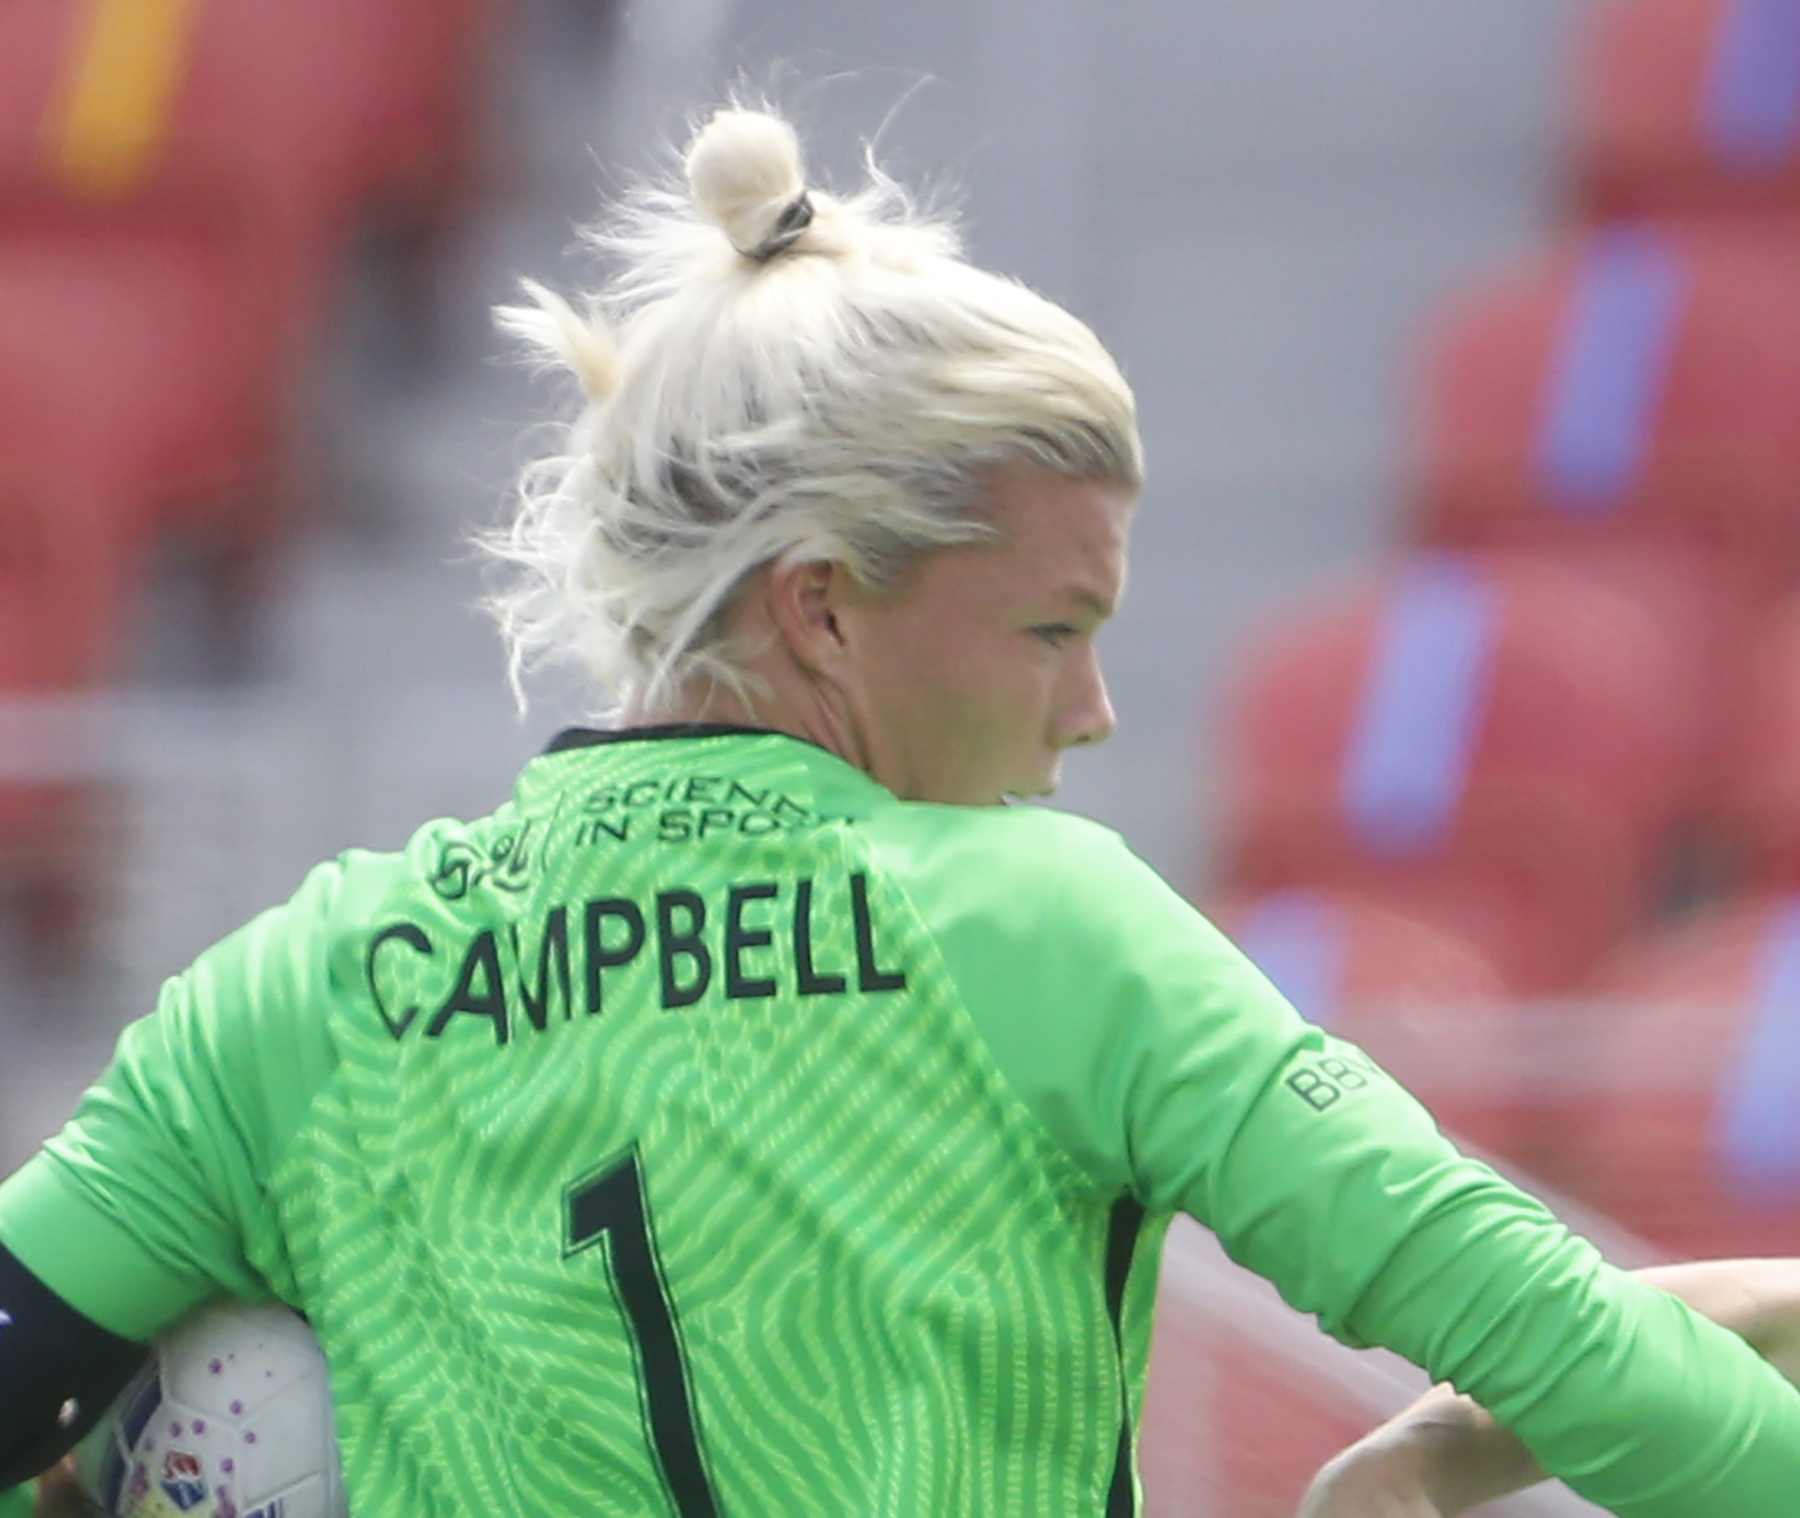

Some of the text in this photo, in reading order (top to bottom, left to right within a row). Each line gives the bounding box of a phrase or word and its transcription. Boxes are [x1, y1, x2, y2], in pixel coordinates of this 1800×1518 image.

[582, 776, 811, 818] SCIEN
[574, 808, 845, 848] IN SPO
[366, 872, 908, 1045] CAMPBELL
